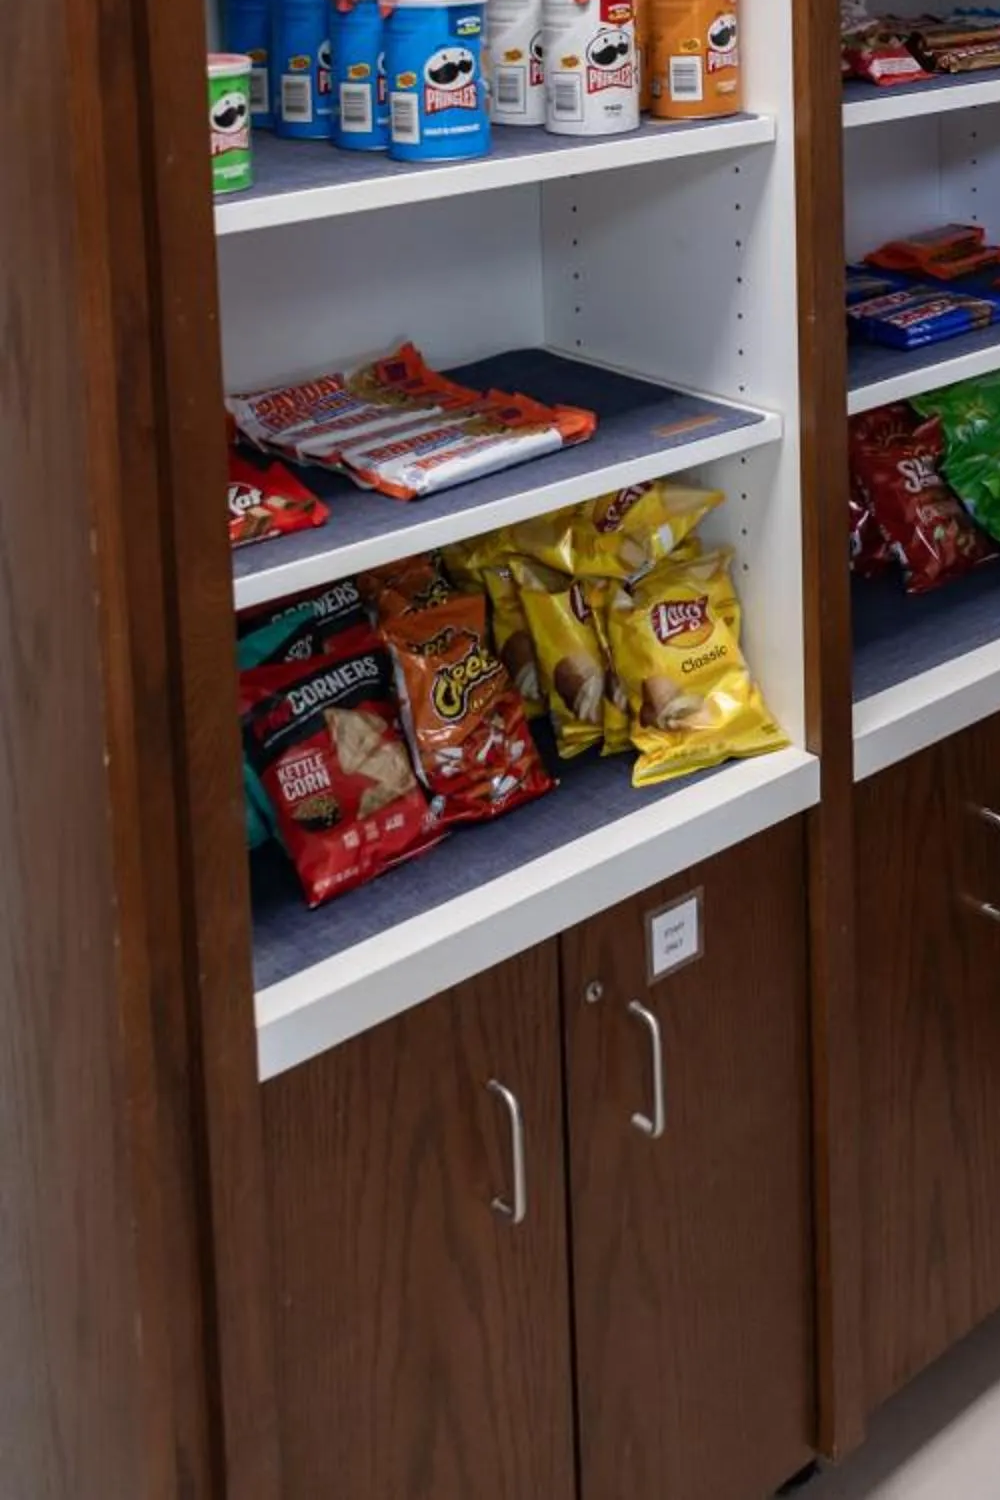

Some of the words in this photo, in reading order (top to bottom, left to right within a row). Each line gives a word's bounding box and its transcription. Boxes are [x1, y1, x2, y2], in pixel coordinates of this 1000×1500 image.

[681, 645, 728, 674] Classic
[288, 656, 379, 714] CORNERS
[276, 752, 323, 784] KETTLE
[283, 768, 331, 801] CORN
